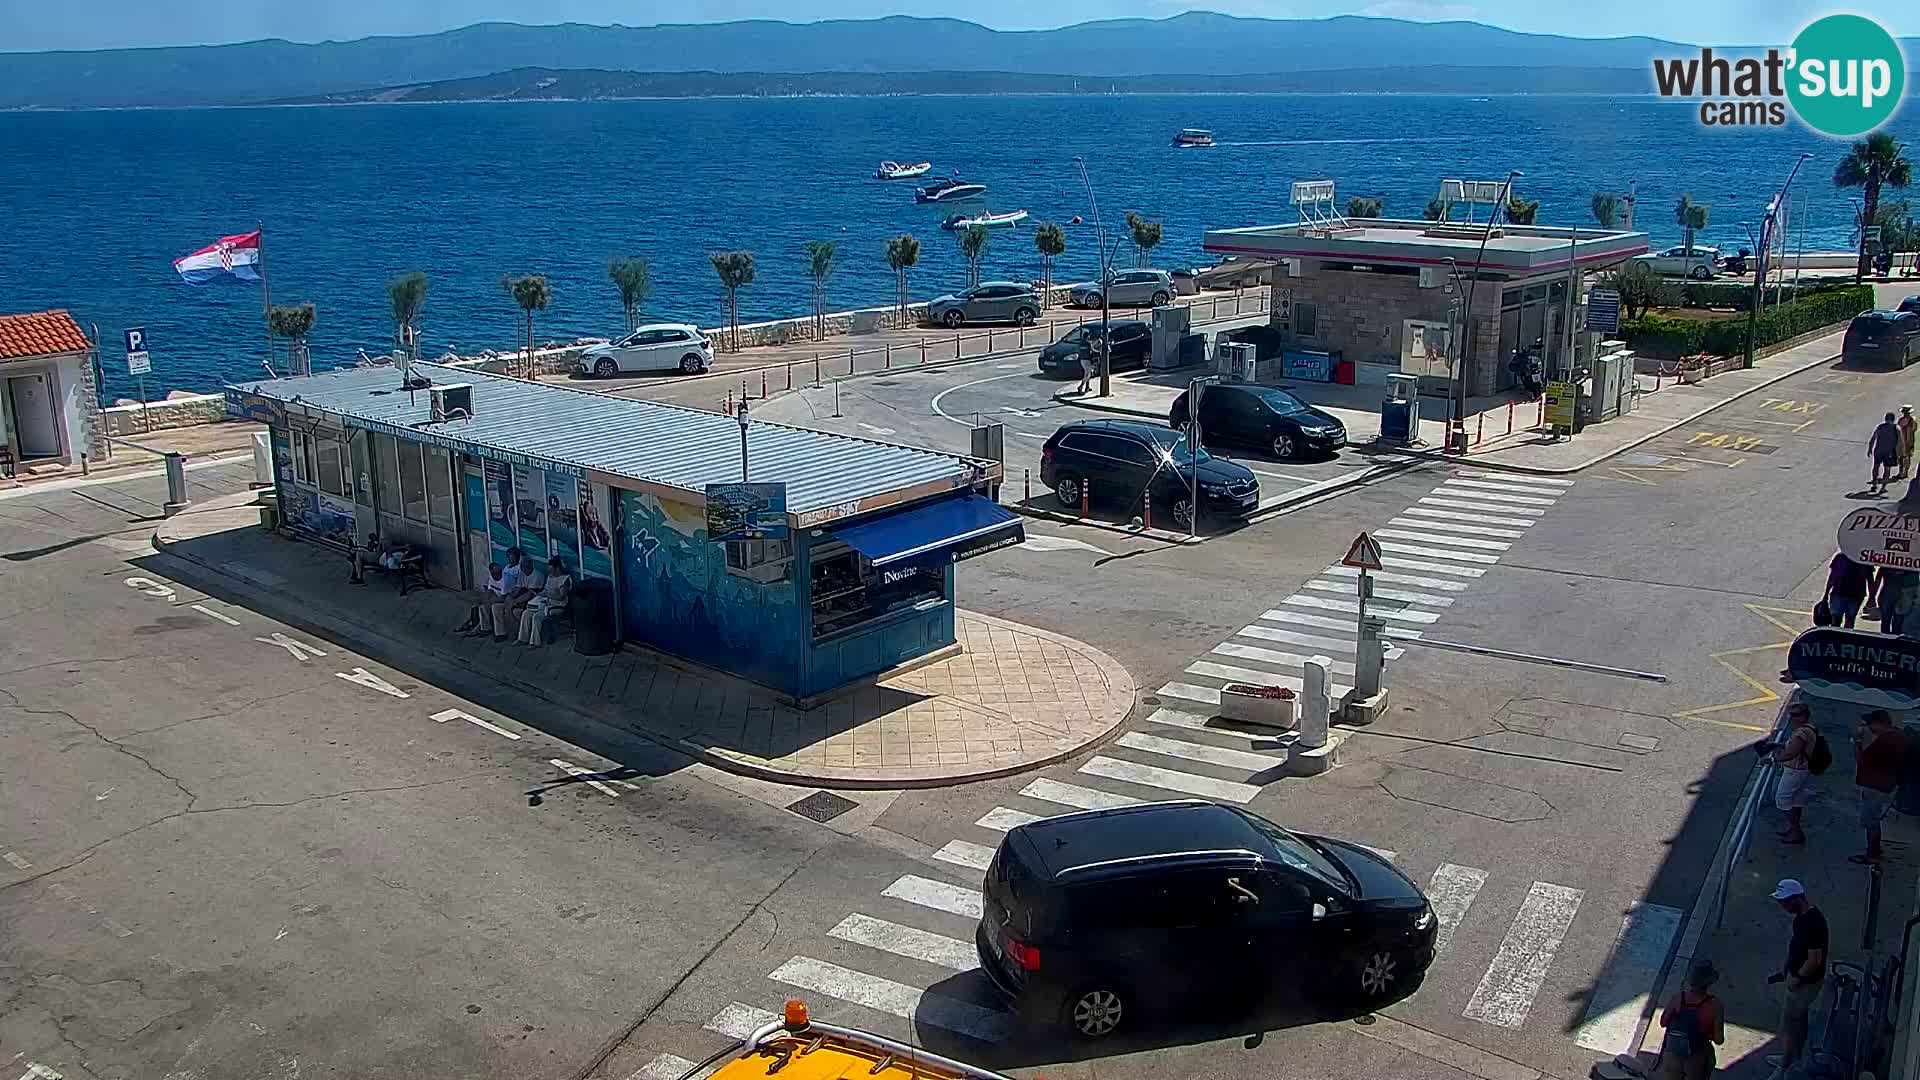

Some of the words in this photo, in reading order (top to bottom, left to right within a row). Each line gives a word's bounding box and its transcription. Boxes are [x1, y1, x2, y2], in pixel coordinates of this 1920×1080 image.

[130, 331, 142, 350] P
[1759, 398, 1828, 415] TAXI
[1686, 432, 1764, 451] TAXI
[436, 436, 467, 451] POSTAJA
[478, 445, 492, 459] BUS
[493, 449, 526, 466] STATION
[528, 456, 554, 470] TICKET
[555, 462, 582, 477] OFFICE
[1848, 514, 1920, 534] PIZZE
[1800, 642, 1920, 674] MARINER
[1871, 665, 1896, 679] bar
